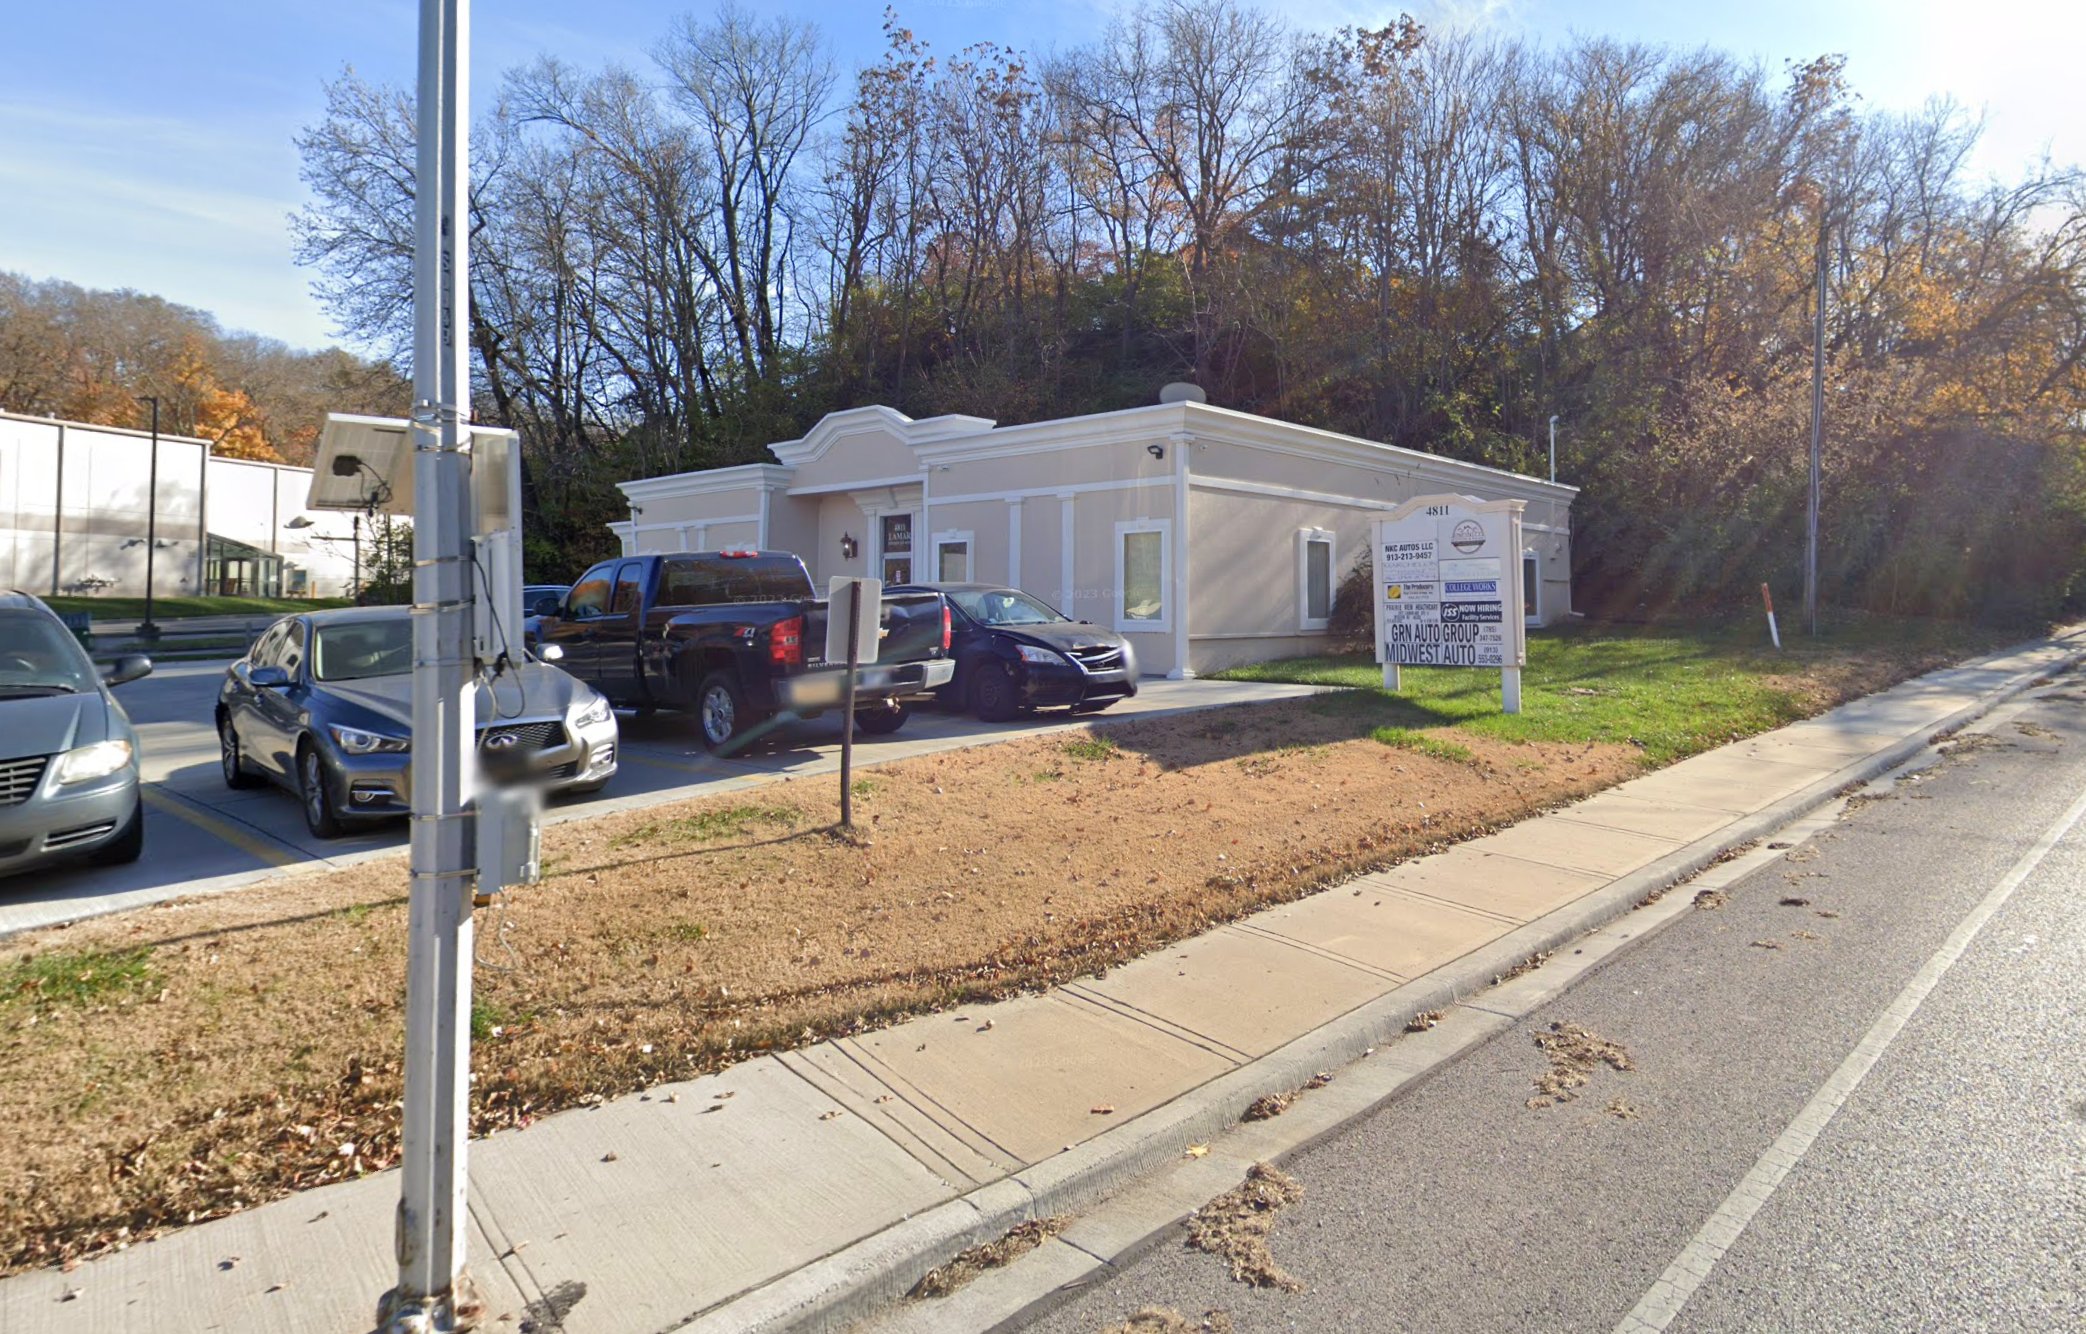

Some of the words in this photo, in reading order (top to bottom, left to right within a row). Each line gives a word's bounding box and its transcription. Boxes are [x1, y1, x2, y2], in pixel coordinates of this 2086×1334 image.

[1426, 505, 1449, 516] 4811
[1384, 544, 1399, 553] NKC
[1399, 543, 1421, 552] AUTOS
[1421, 541, 1434, 550] LLC
[1445, 582, 1473, 592] COLLEGE
[1472, 581, 1496, 591] WORKS
[1459, 604, 1477, 613] NOW
[1477, 604, 1502, 612] HIRING
[1392, 623, 1412, 643] GRN
[1414, 623, 1441, 643] AUTO
[1443, 623, 1480, 643] GROUP
[1385, 642, 1441, 664] MIDWEST
[1443, 643, 1476, 665] AUTO
